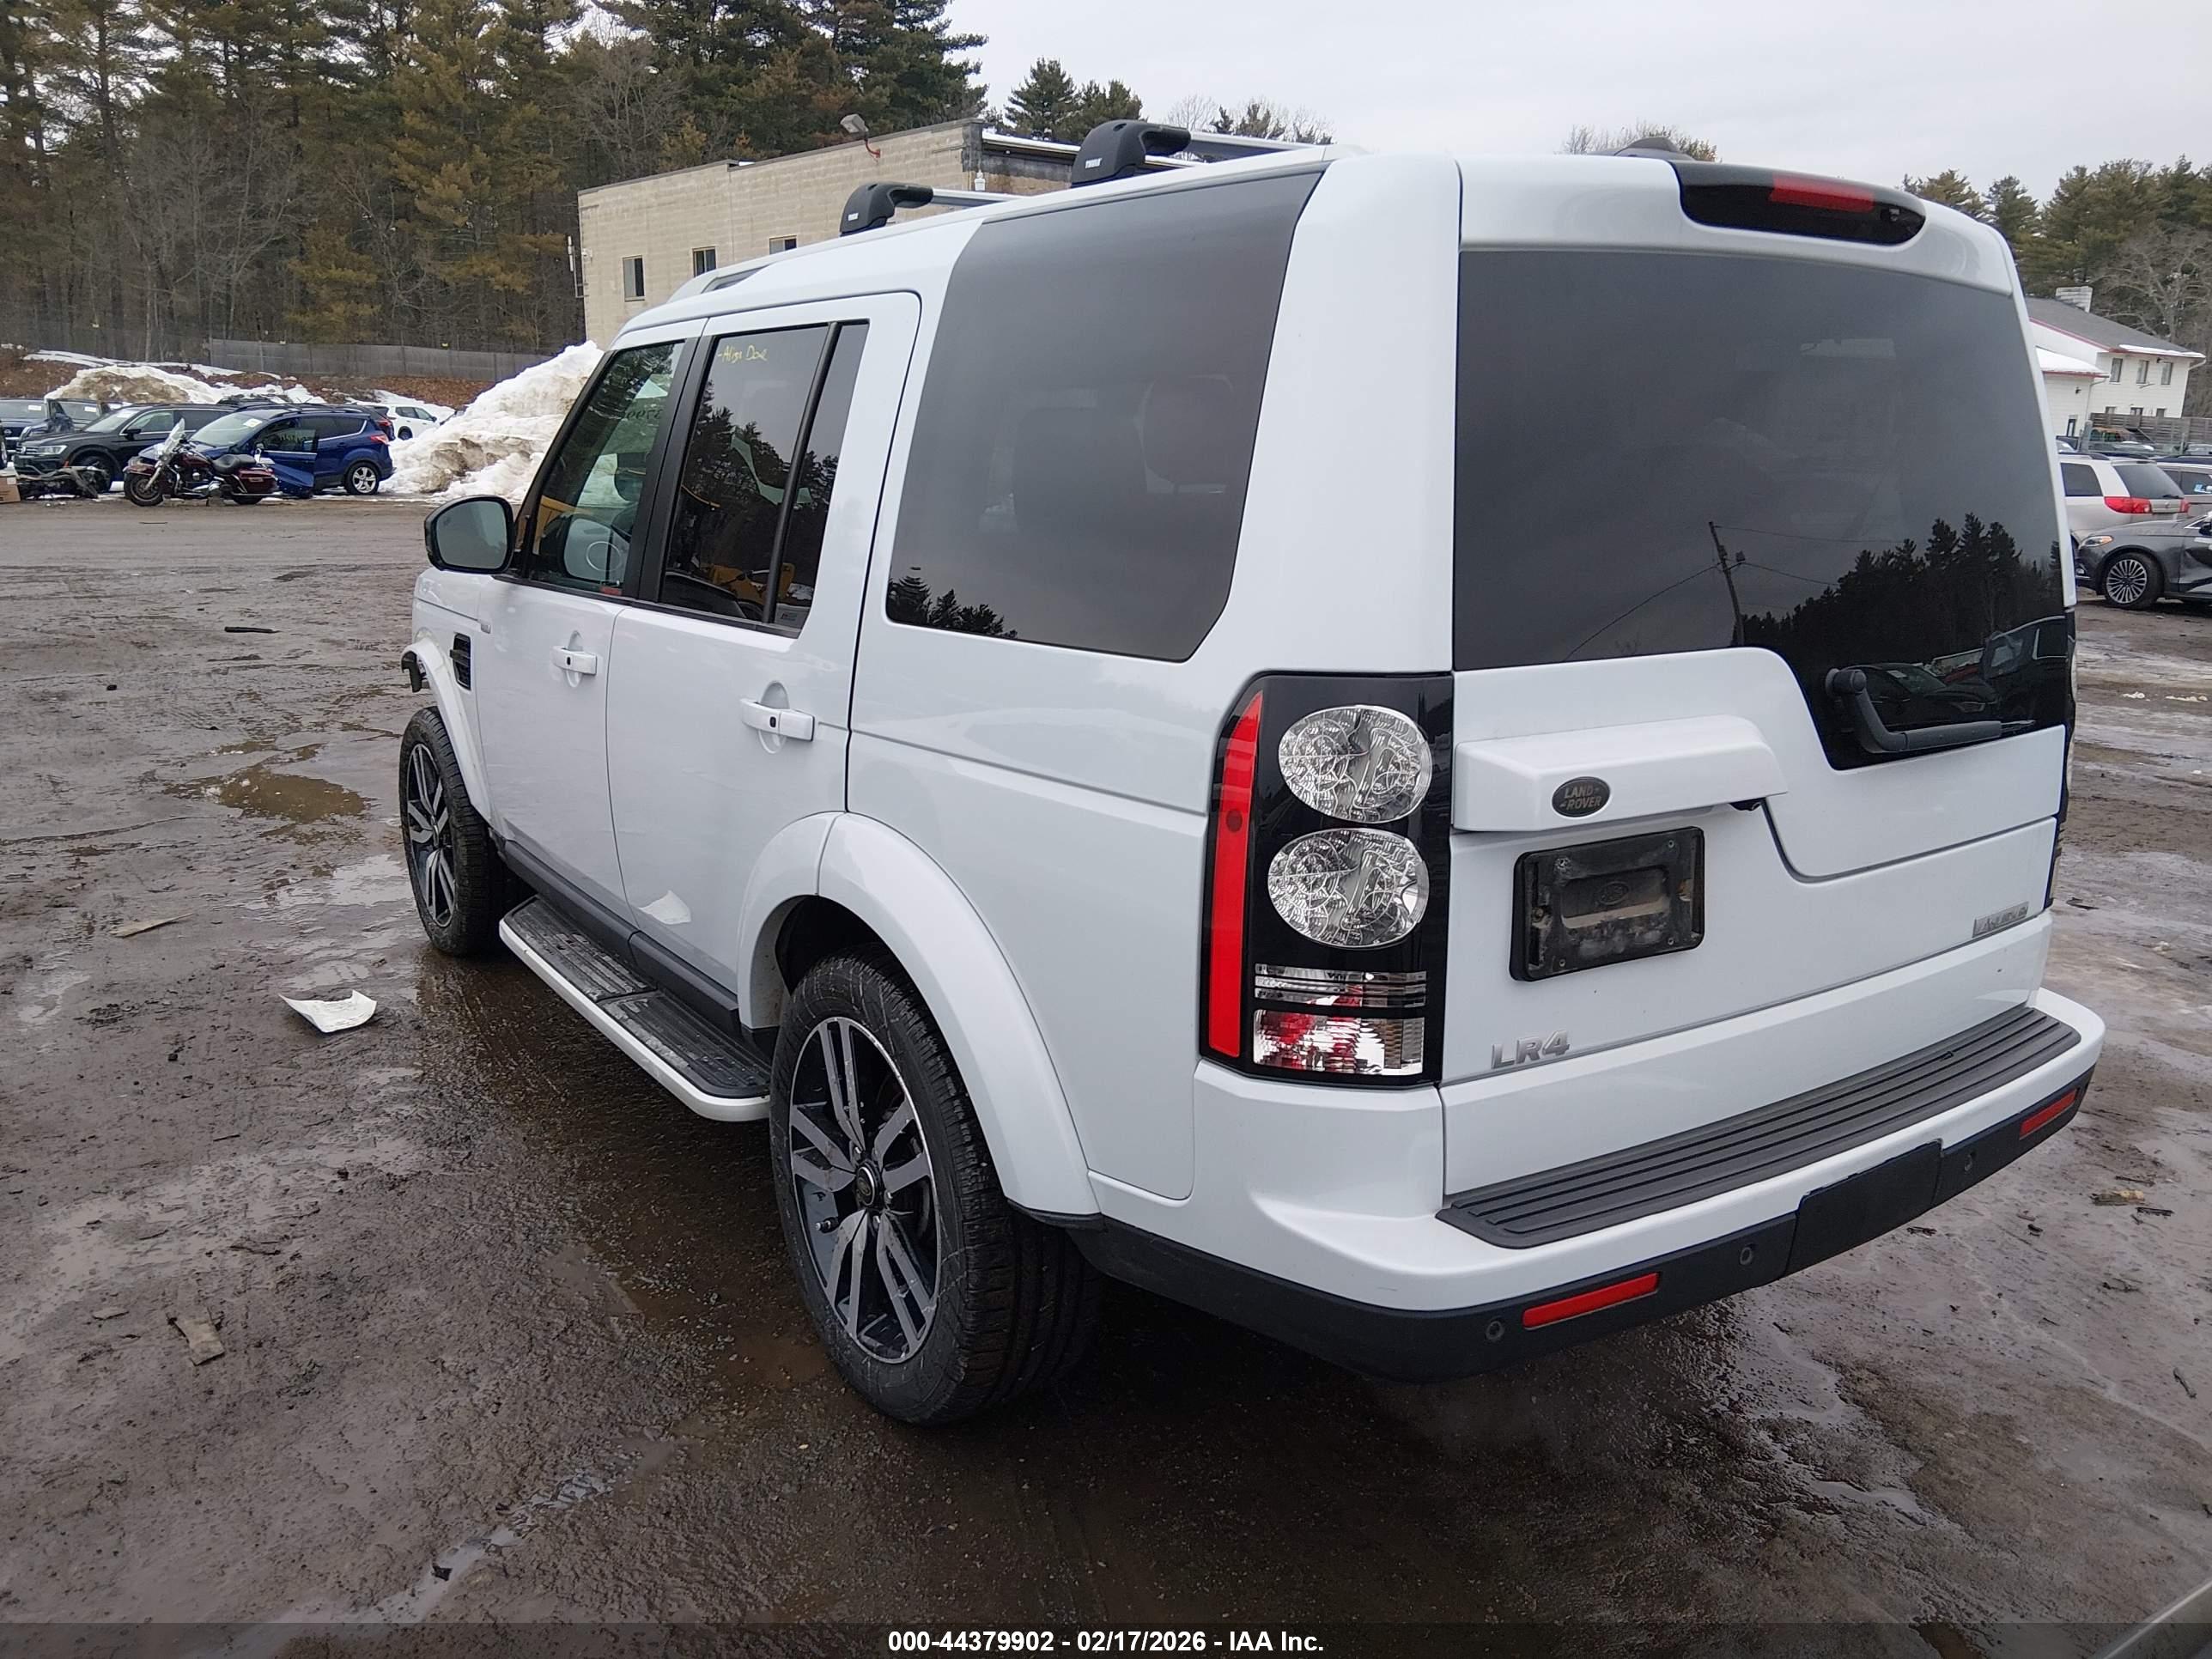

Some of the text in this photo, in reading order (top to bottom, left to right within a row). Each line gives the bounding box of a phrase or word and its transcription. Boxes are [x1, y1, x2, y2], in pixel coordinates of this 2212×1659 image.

[1565, 783, 1594, 799] LAND
[1566, 795, 1602, 811] ROVER
[1491, 1029, 1571, 1070] LR4
